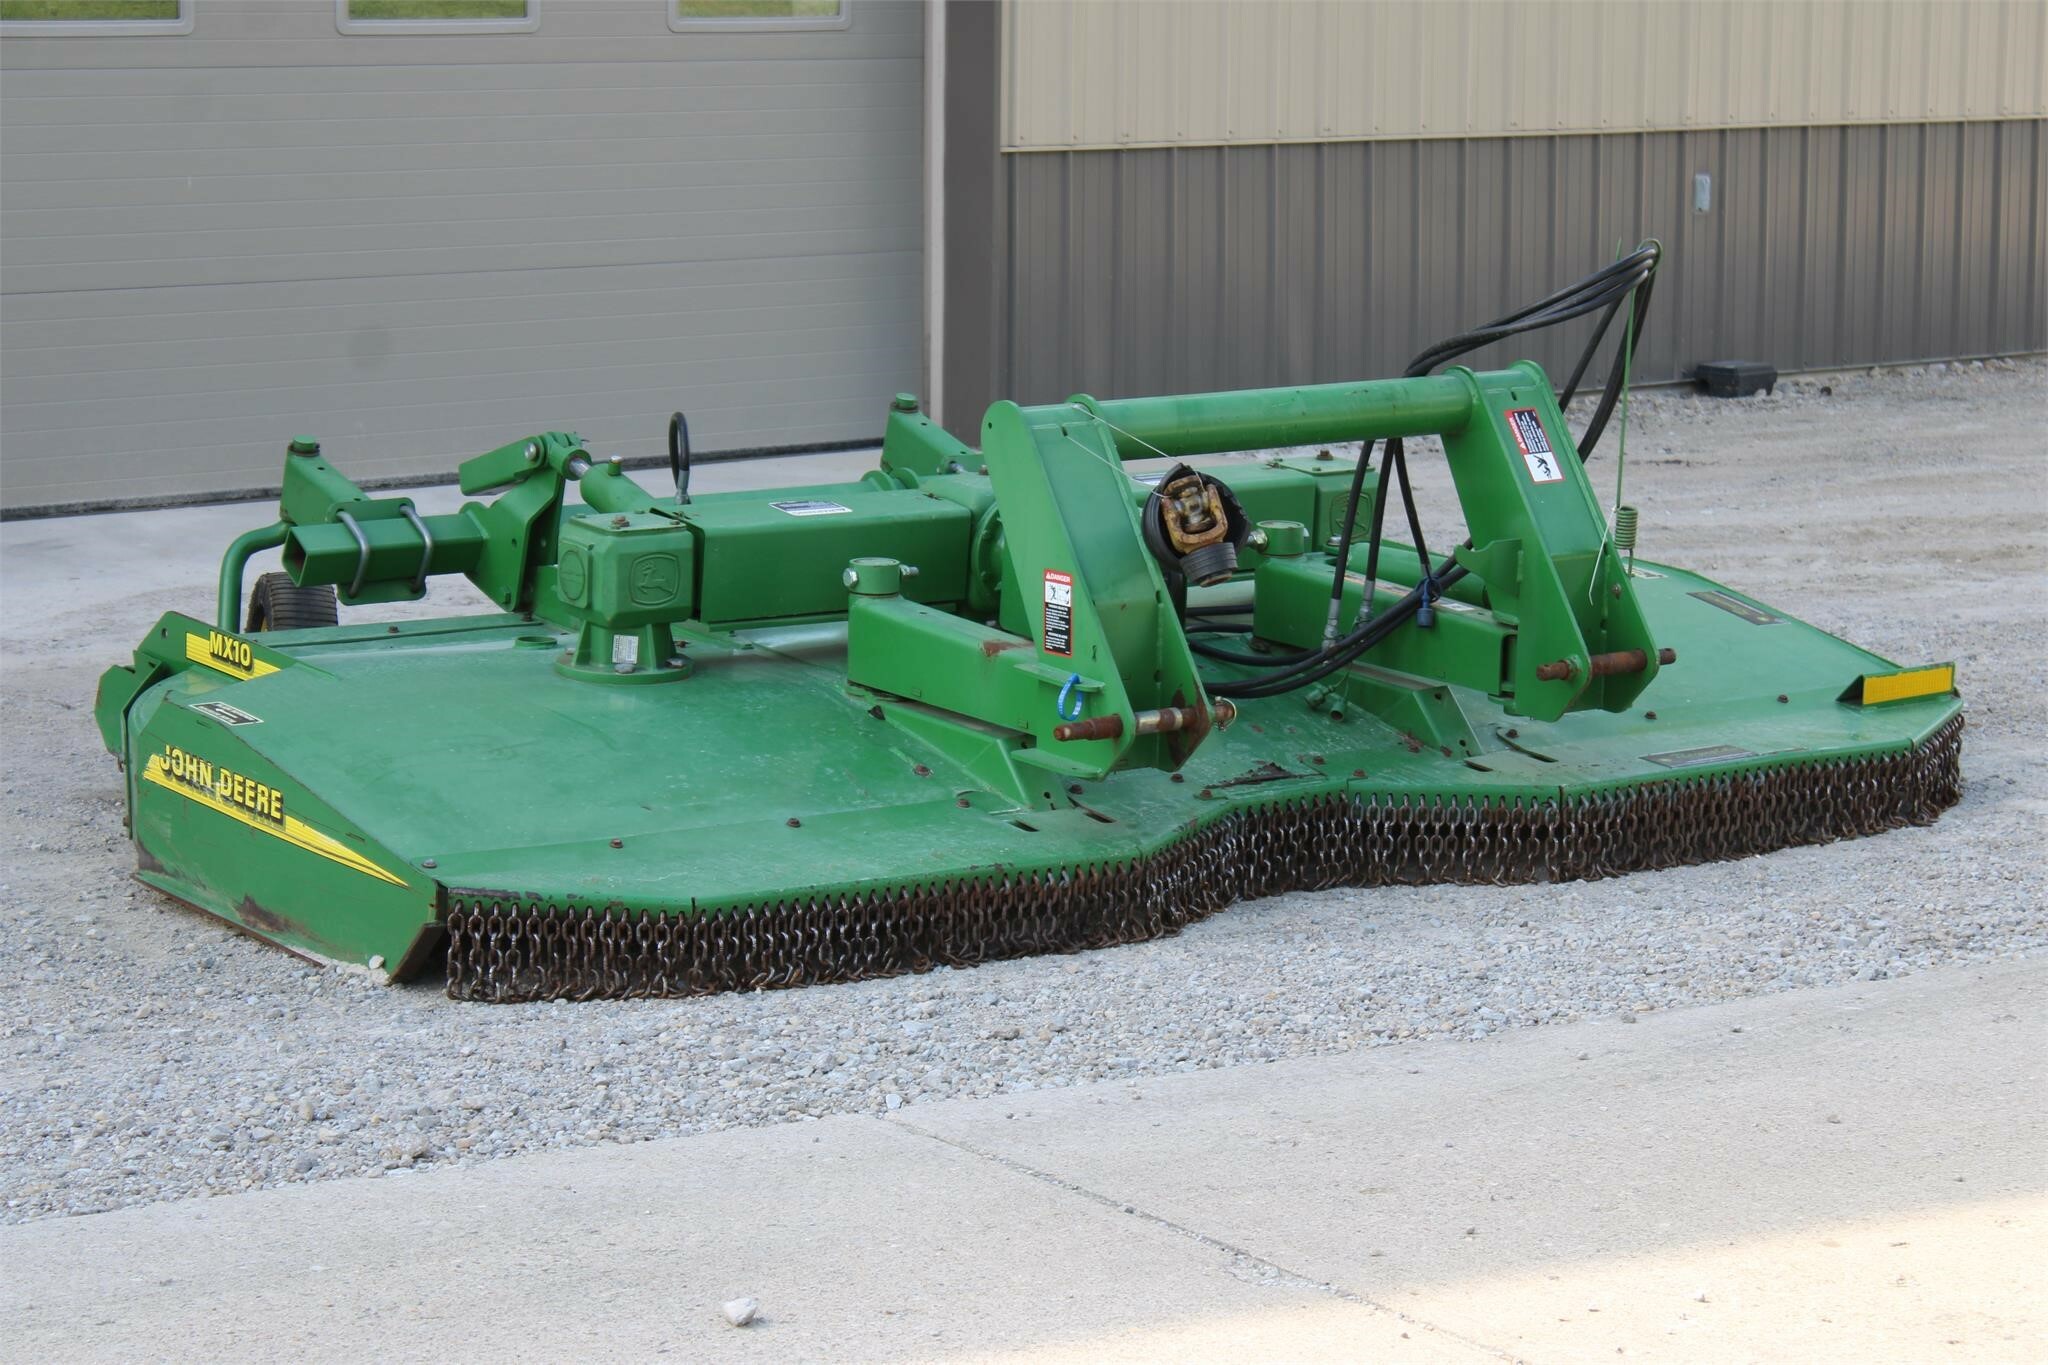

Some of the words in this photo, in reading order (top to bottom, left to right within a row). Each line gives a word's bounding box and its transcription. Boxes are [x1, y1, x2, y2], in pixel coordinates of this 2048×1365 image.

[208, 631, 253, 669] MX10
[158, 744, 213, 788] JOHN
[218, 767, 284, 820] DEERE
